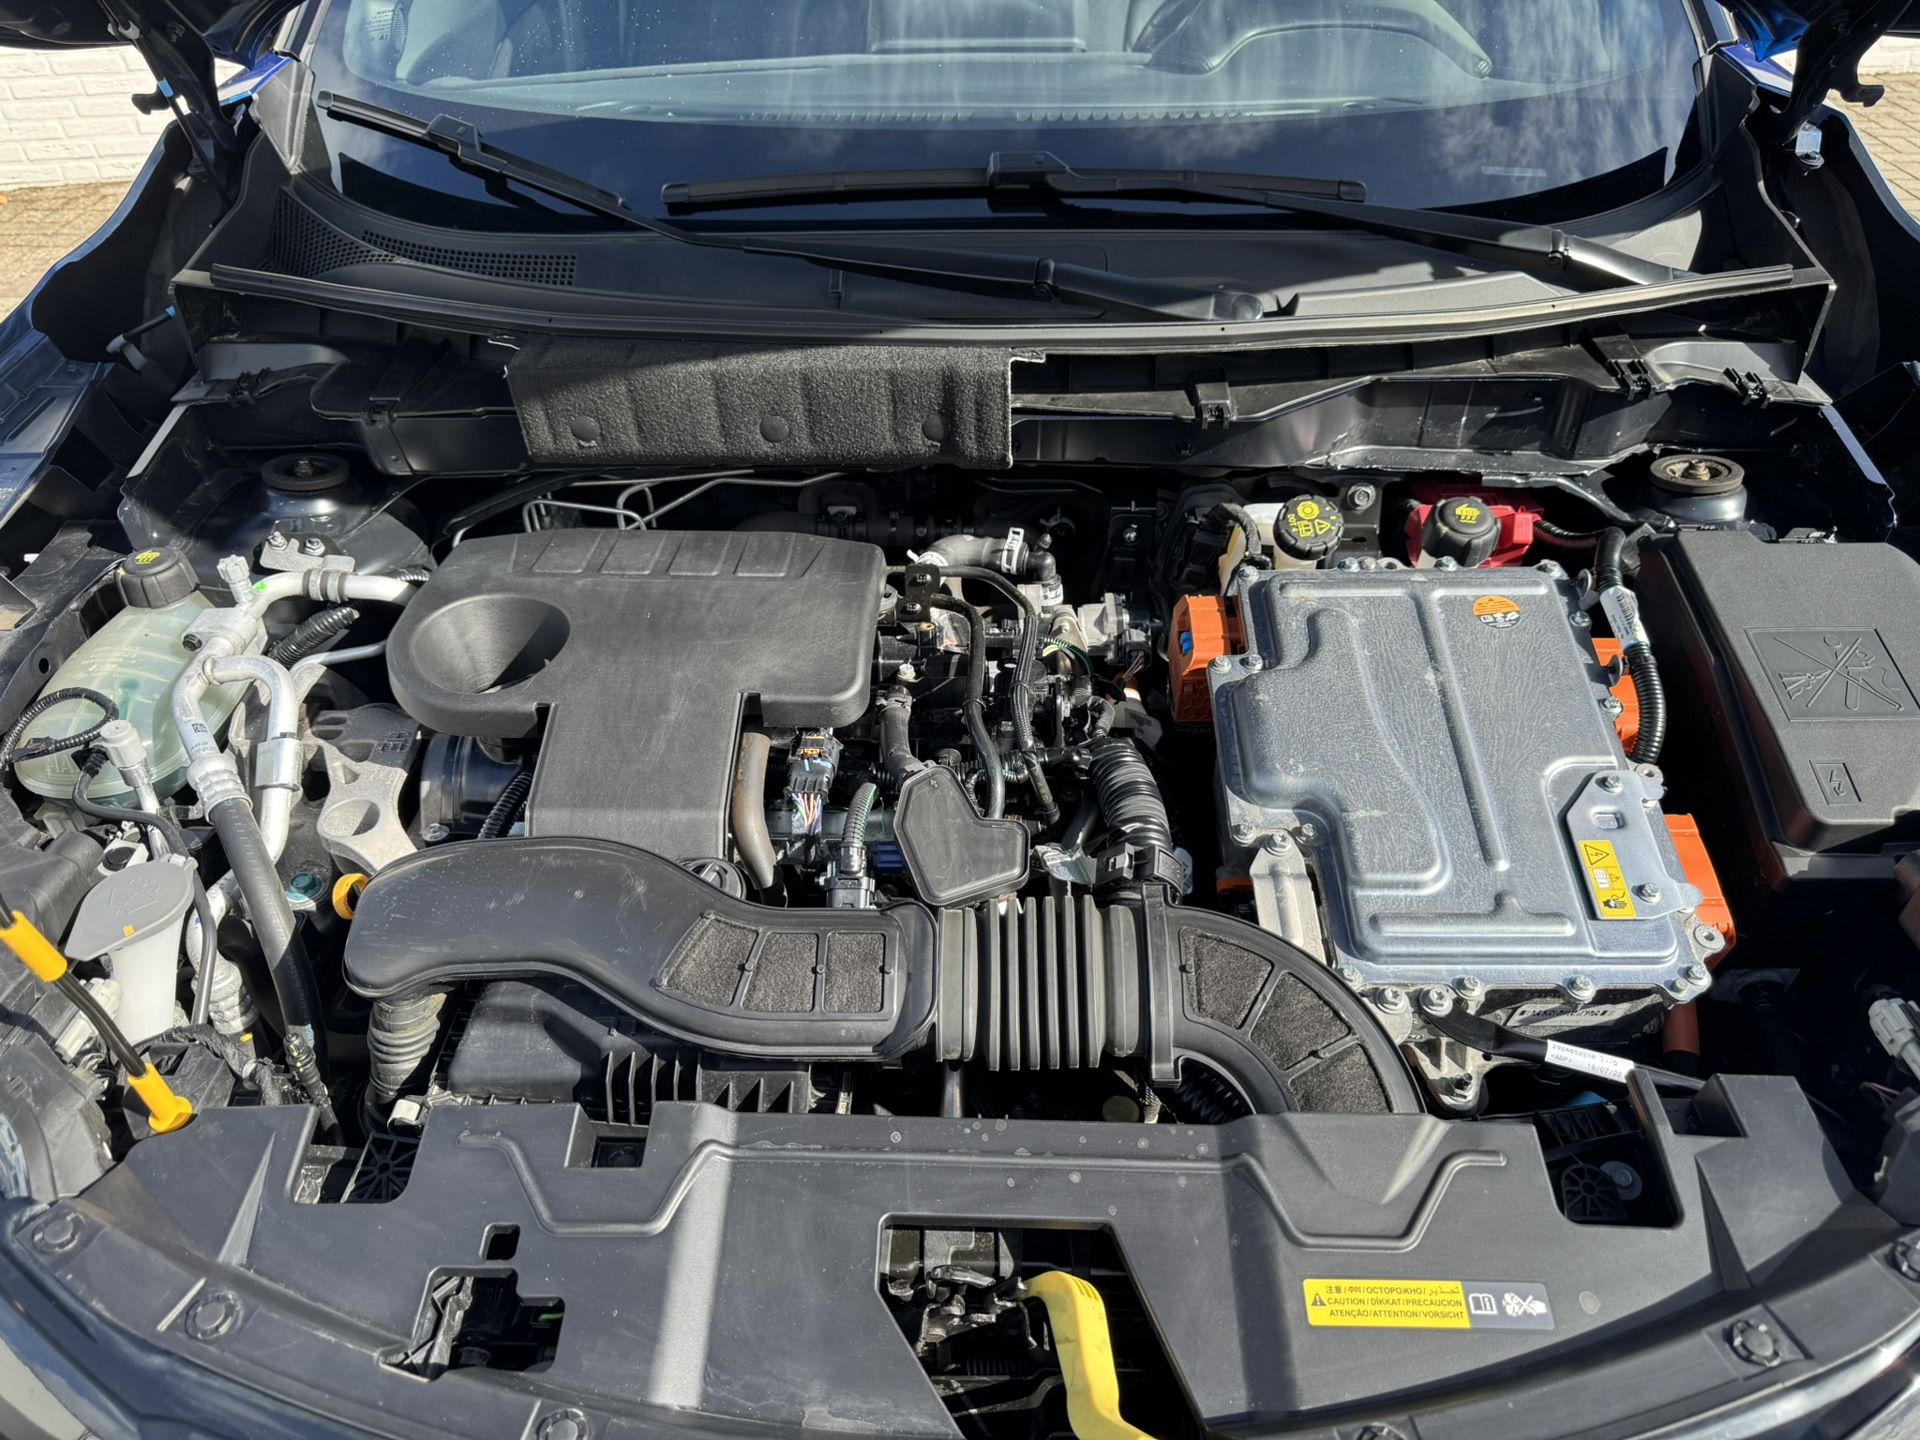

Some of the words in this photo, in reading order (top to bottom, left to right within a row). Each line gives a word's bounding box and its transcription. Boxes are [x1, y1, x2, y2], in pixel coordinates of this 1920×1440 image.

[1325, 1285, 1342, 1294] 注意
[1327, 1297, 1366, 1305] CAUTION
[1405, 1299, 1462, 1307] PRECAUCION
[1329, 1308, 1369, 1318] ATENÇÃO
[1372, 1309, 1419, 1318] ATTENTION
[1421, 1310, 1464, 1319] VORSICHT
